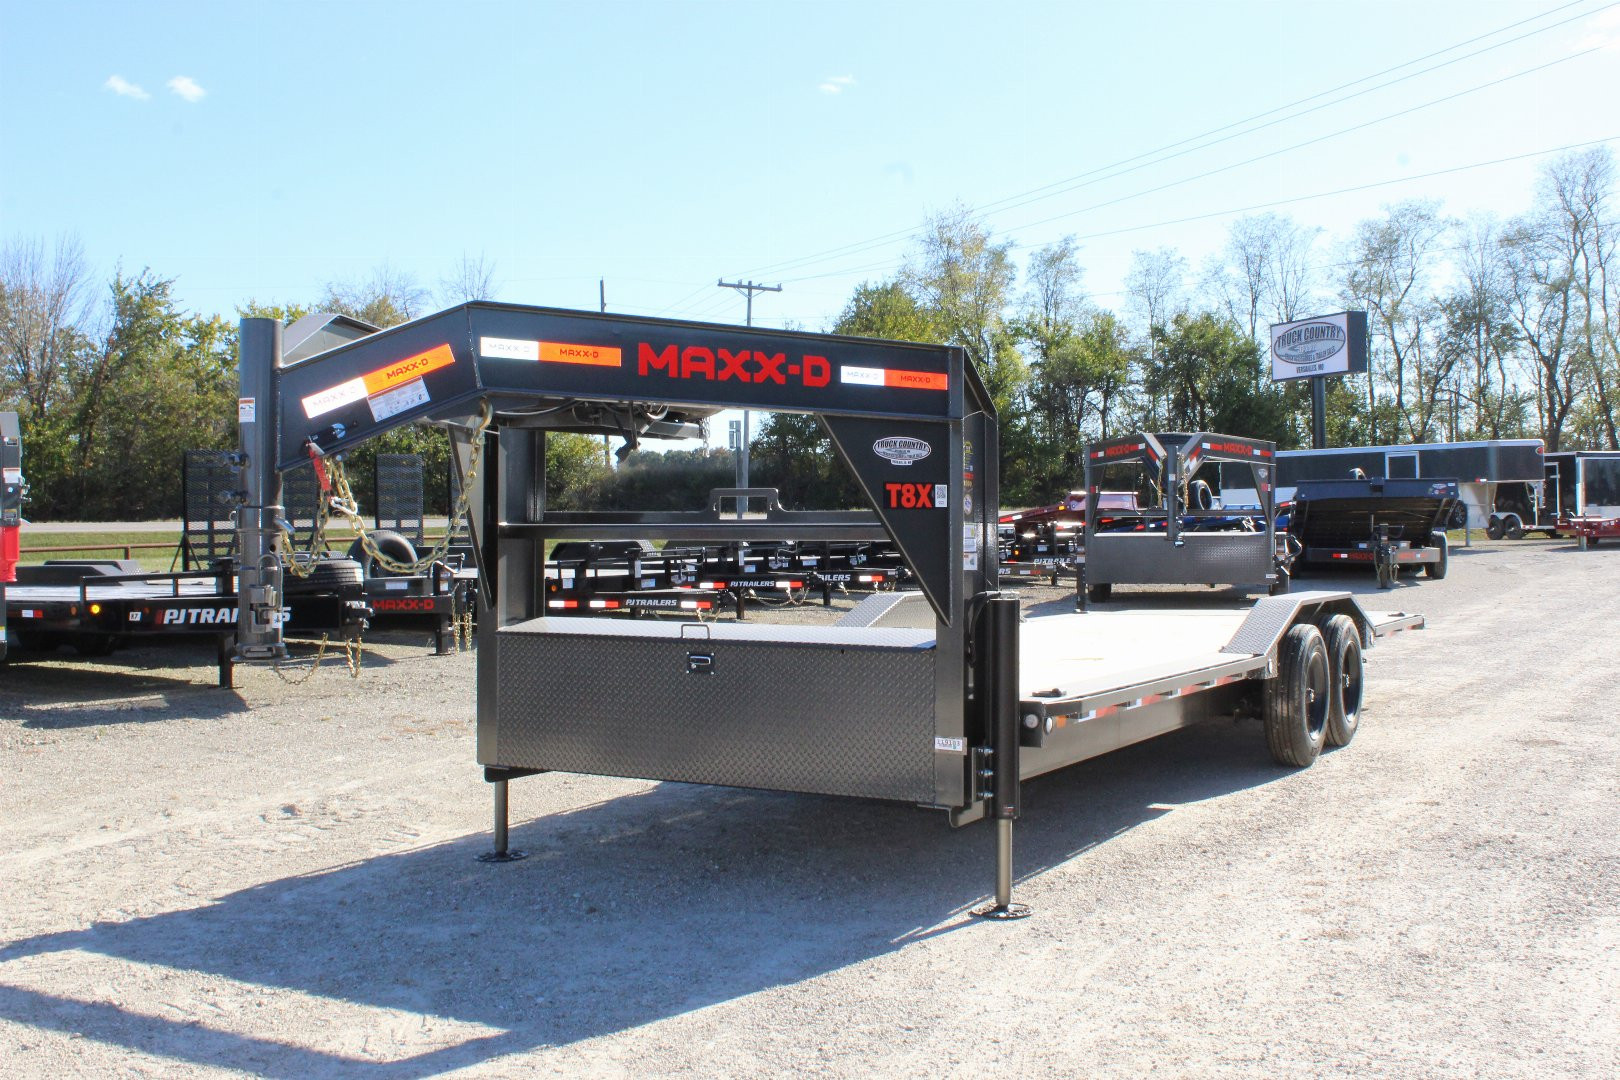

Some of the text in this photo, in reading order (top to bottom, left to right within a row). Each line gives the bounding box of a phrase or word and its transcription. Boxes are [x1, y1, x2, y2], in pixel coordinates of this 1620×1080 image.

[1277, 325, 1341, 348] TRUCK COUNTRY
[559, 348, 599, 359] MAXX-D
[386, 358, 429, 380] MAXX-D
[638, 342, 831, 388] MAXX-D
[900, 375, 931, 384] MAXX-D
[877, 440, 927, 450] TRUCK COUNTRY
[885, 483, 933, 509] T8X
[372, 599, 434, 611] MAXX-D
[163, 608, 187, 624] PJ
